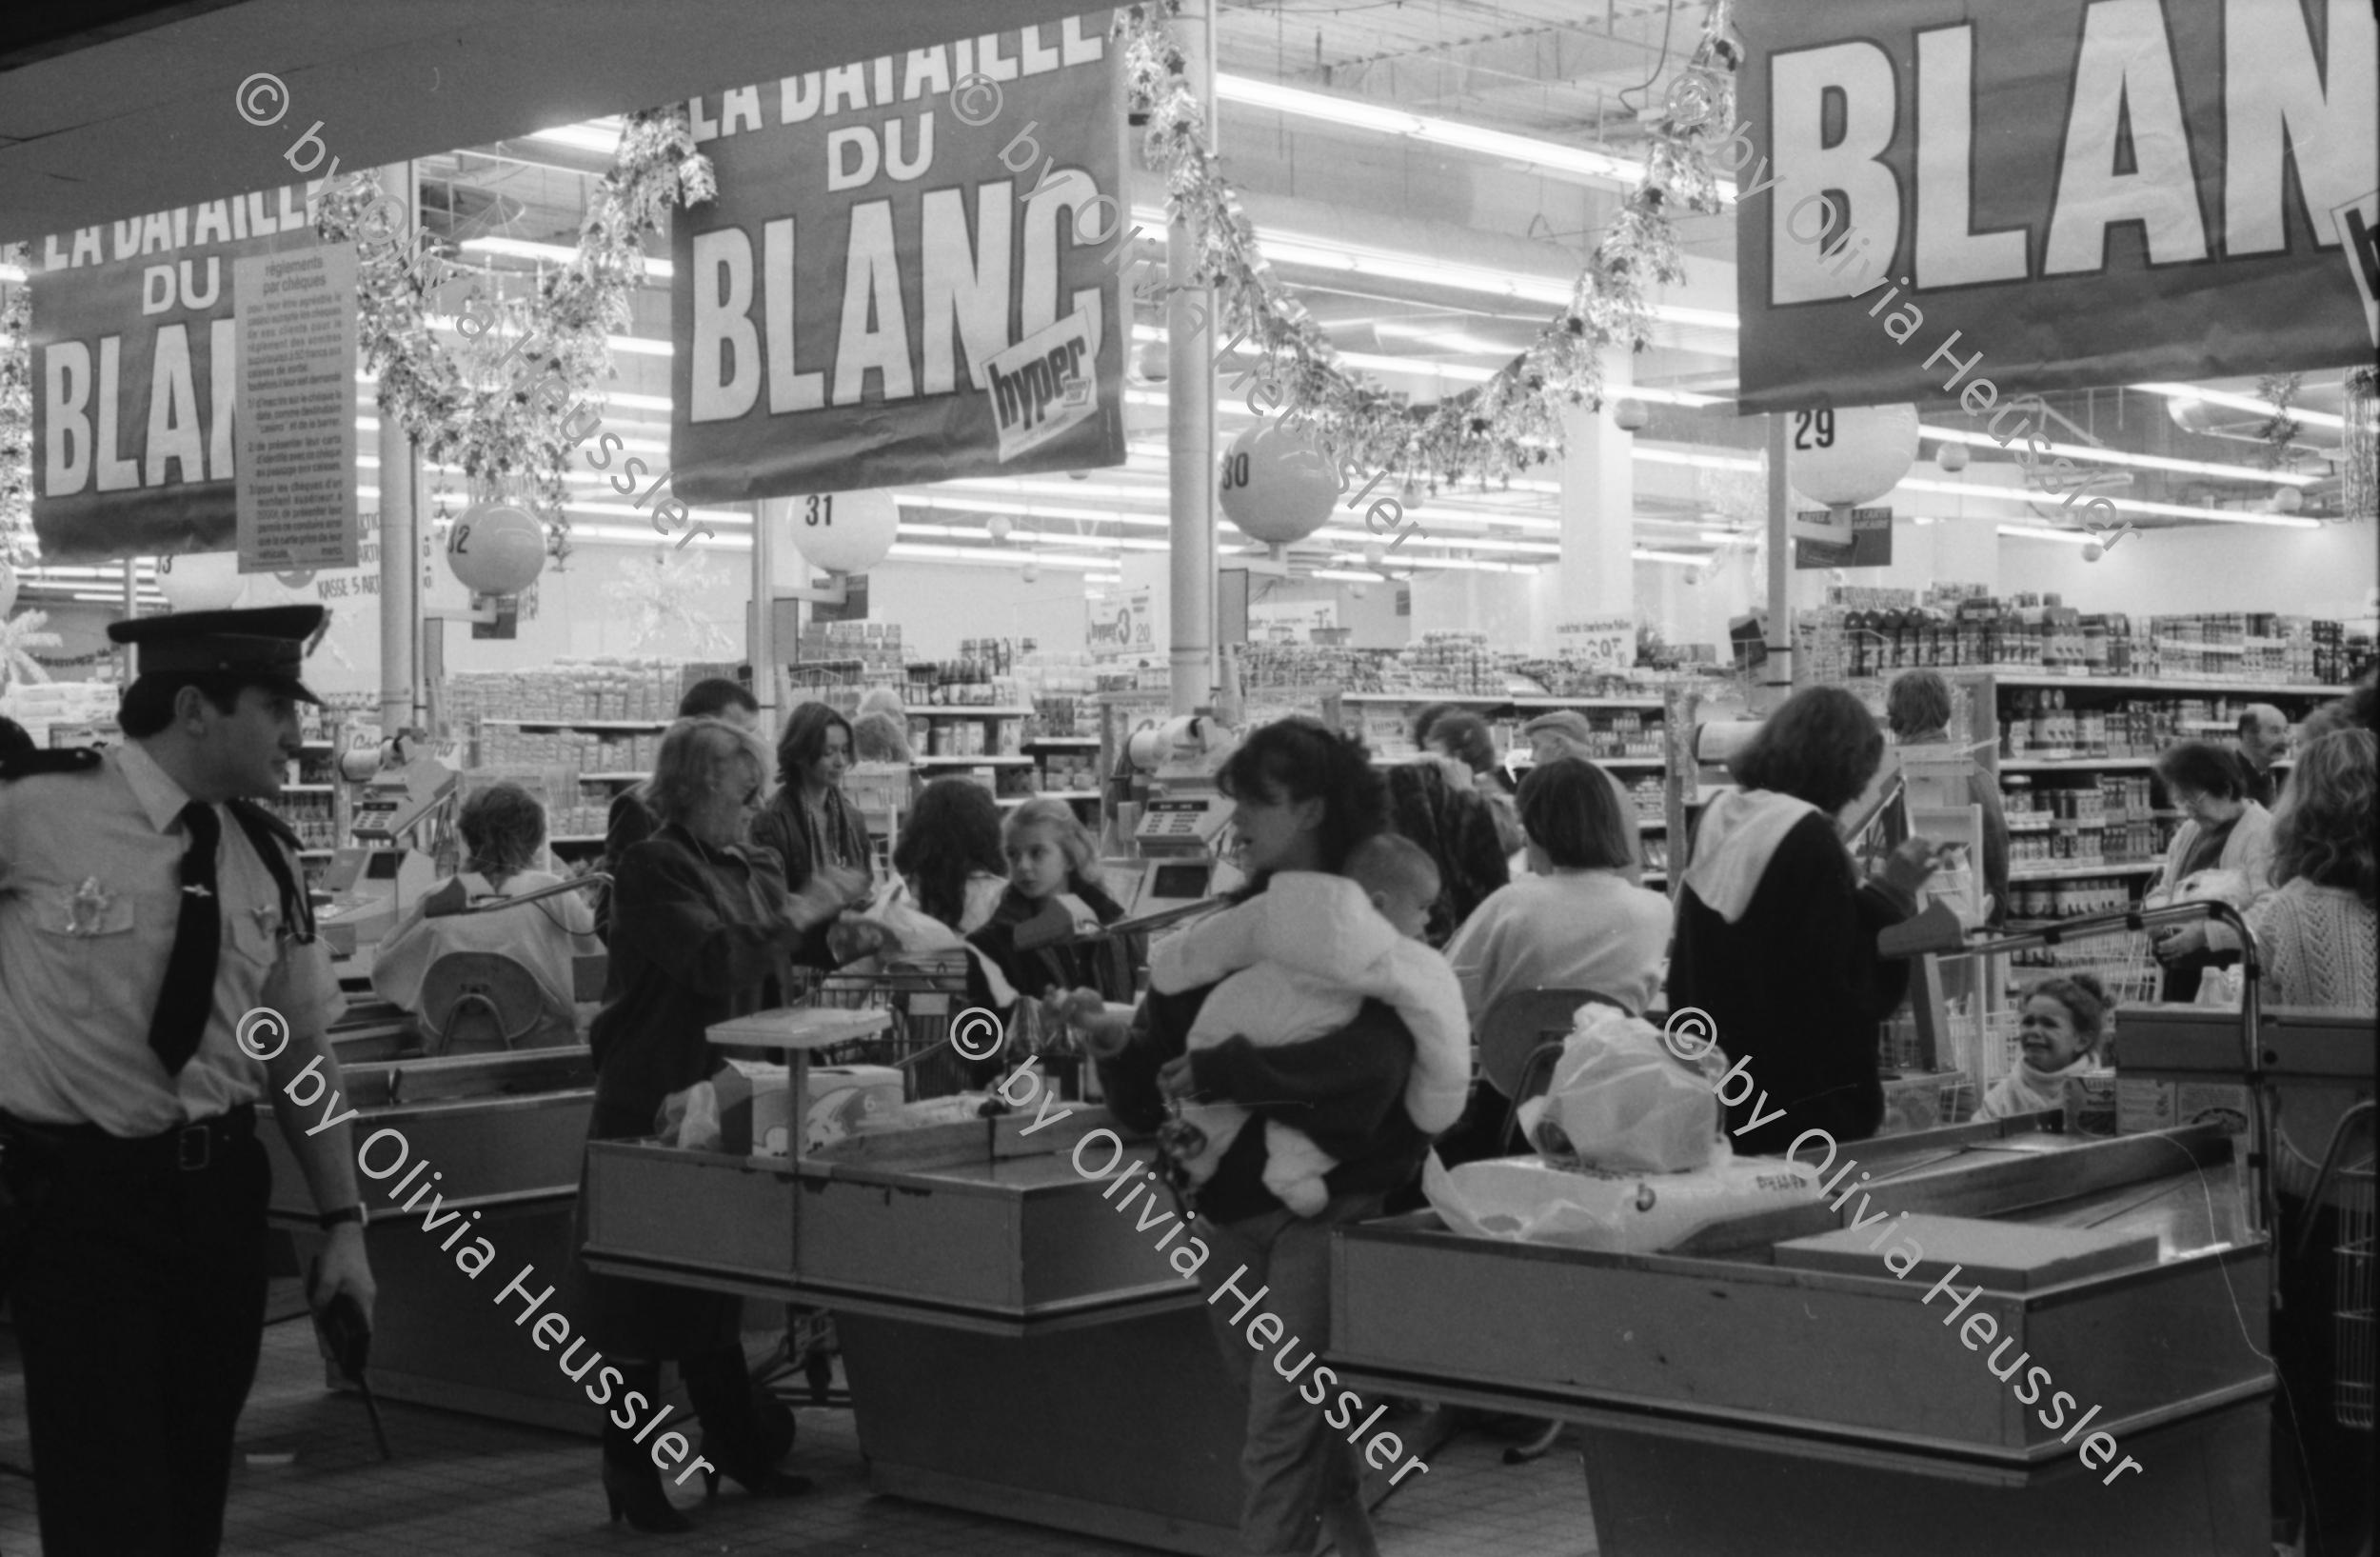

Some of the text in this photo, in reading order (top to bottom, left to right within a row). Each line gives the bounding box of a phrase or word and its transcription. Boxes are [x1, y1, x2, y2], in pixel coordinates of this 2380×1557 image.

[827, 111, 934, 191] DU
[143, 256, 221, 315] DU
[263, 274, 327, 297] par chèques
[690, 169, 1102, 423] BLANC
[988, 335, 1086, 431] hyper
[1795, 409, 1835, 449] 29
[1221, 451, 1249, 490] 30
[805, 494, 833, 526] 31
[317, 577, 348, 601] KASSE
[351, 575, 360, 595] 5
[1118, 608, 1131, 645] 3
